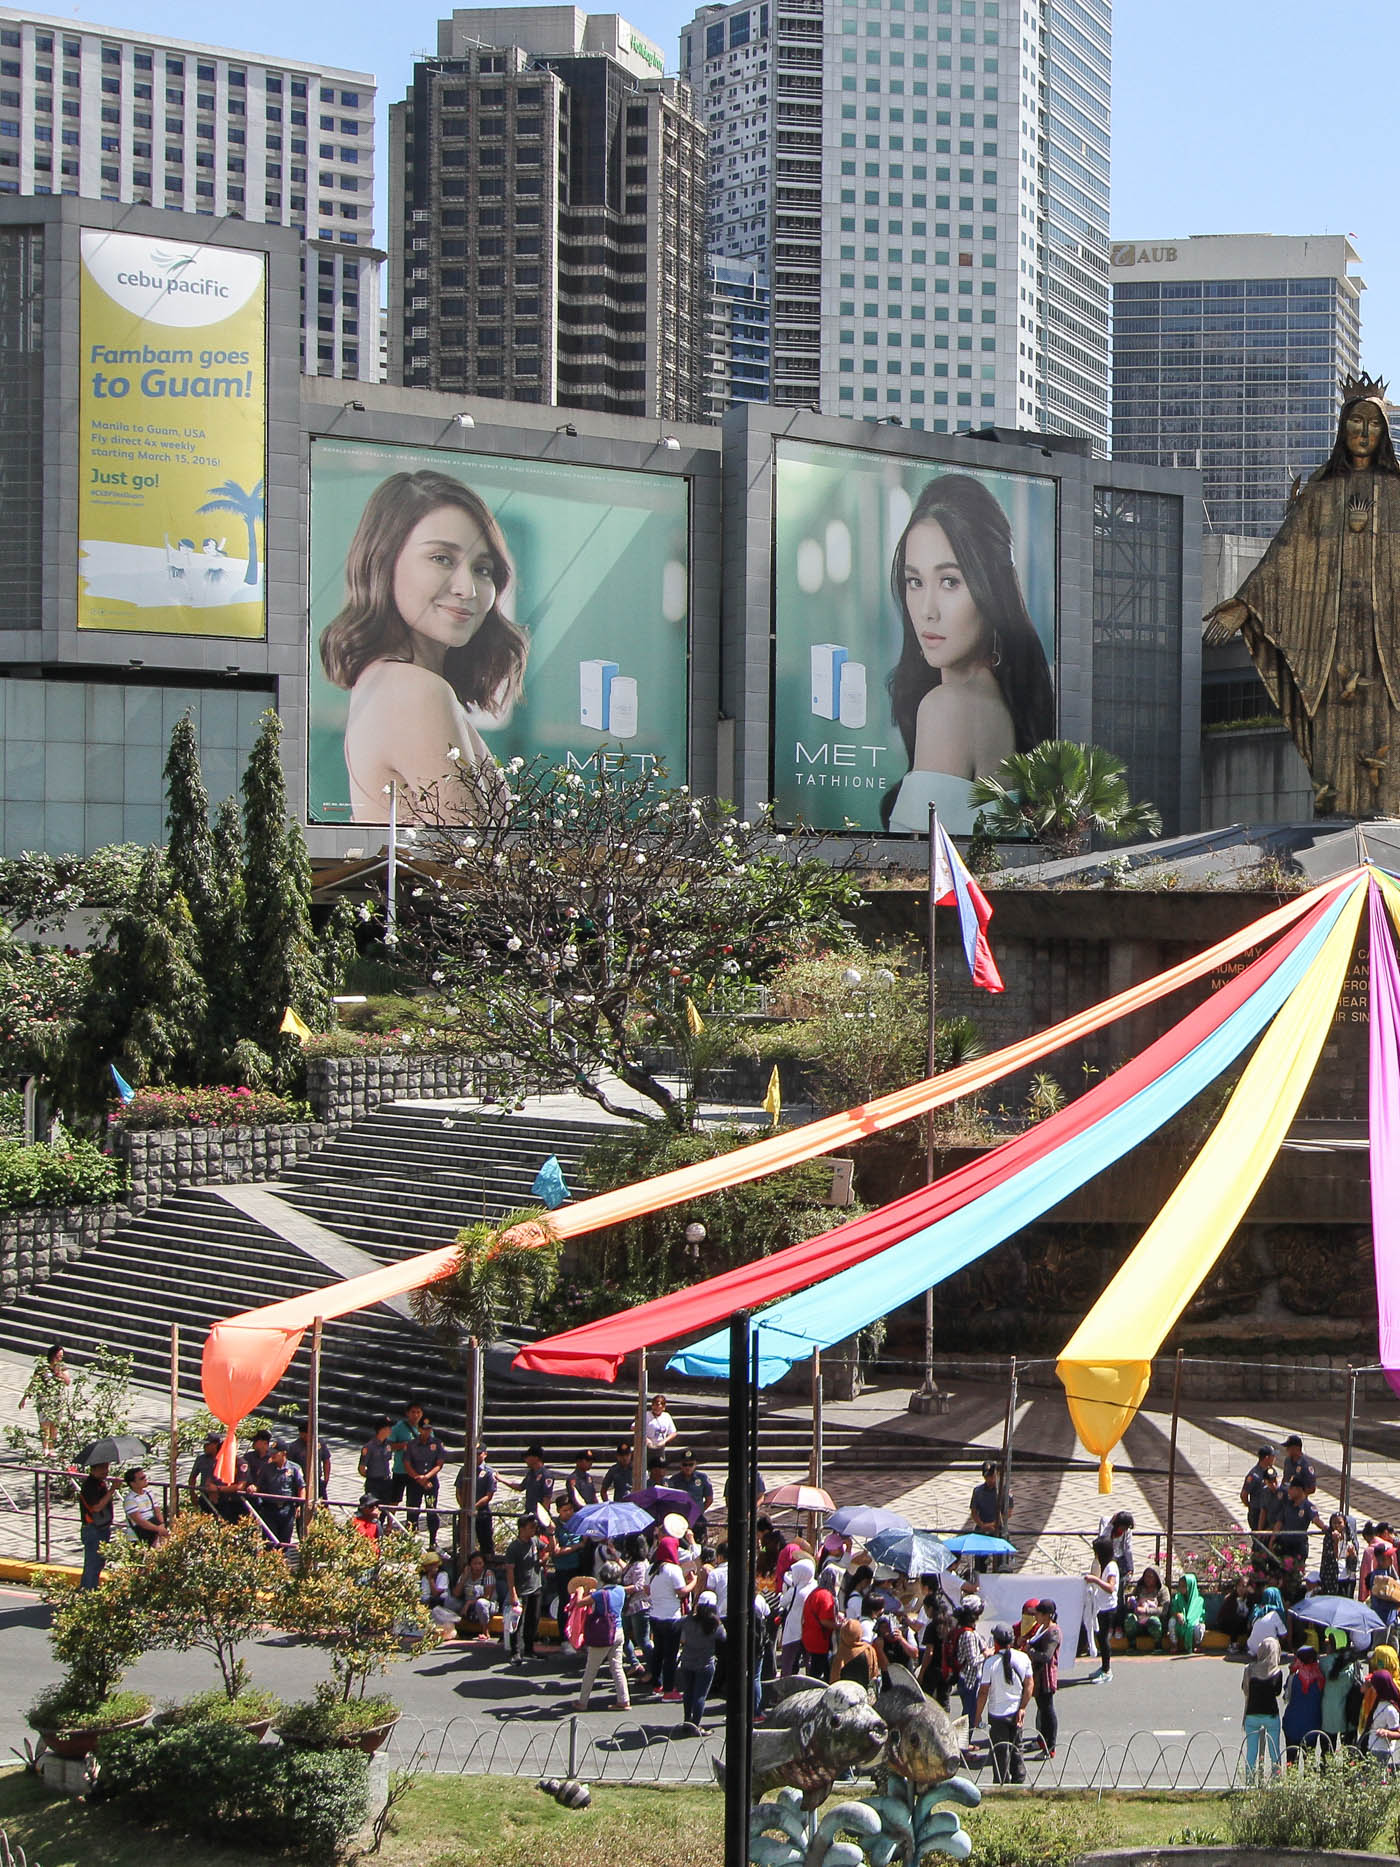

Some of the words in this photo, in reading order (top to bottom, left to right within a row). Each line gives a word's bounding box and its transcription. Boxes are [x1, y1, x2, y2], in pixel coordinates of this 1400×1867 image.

[1136, 247, 1178, 264] AUB
[117, 271, 163, 289] cebu
[167, 279, 230, 298] pacific
[90, 345, 193, 364] Fambam
[199, 349, 250, 369] goes
[92, 373, 131, 398] to
[140, 369, 253, 398] Guam!
[91, 420, 130, 431] Manila
[133, 423, 144, 433] to
[146, 424, 180, 437] Guam,
[184, 428, 206, 439] USA
[91, 433, 106, 444] Fly
[110, 434, 141, 446] direct
[144, 438, 158, 447] 4x
[160, 440, 196, 452] weekly
[91, 448, 135, 460] starting
[137, 451, 171, 462] March
[175, 454, 190, 465] 15,
[90, 468, 128, 485] Just
[132, 473, 159, 490] go!
[566, 750, 656, 773] MET
[795, 742, 888, 768] MET
[795, 773, 887, 789] TATHIONE
